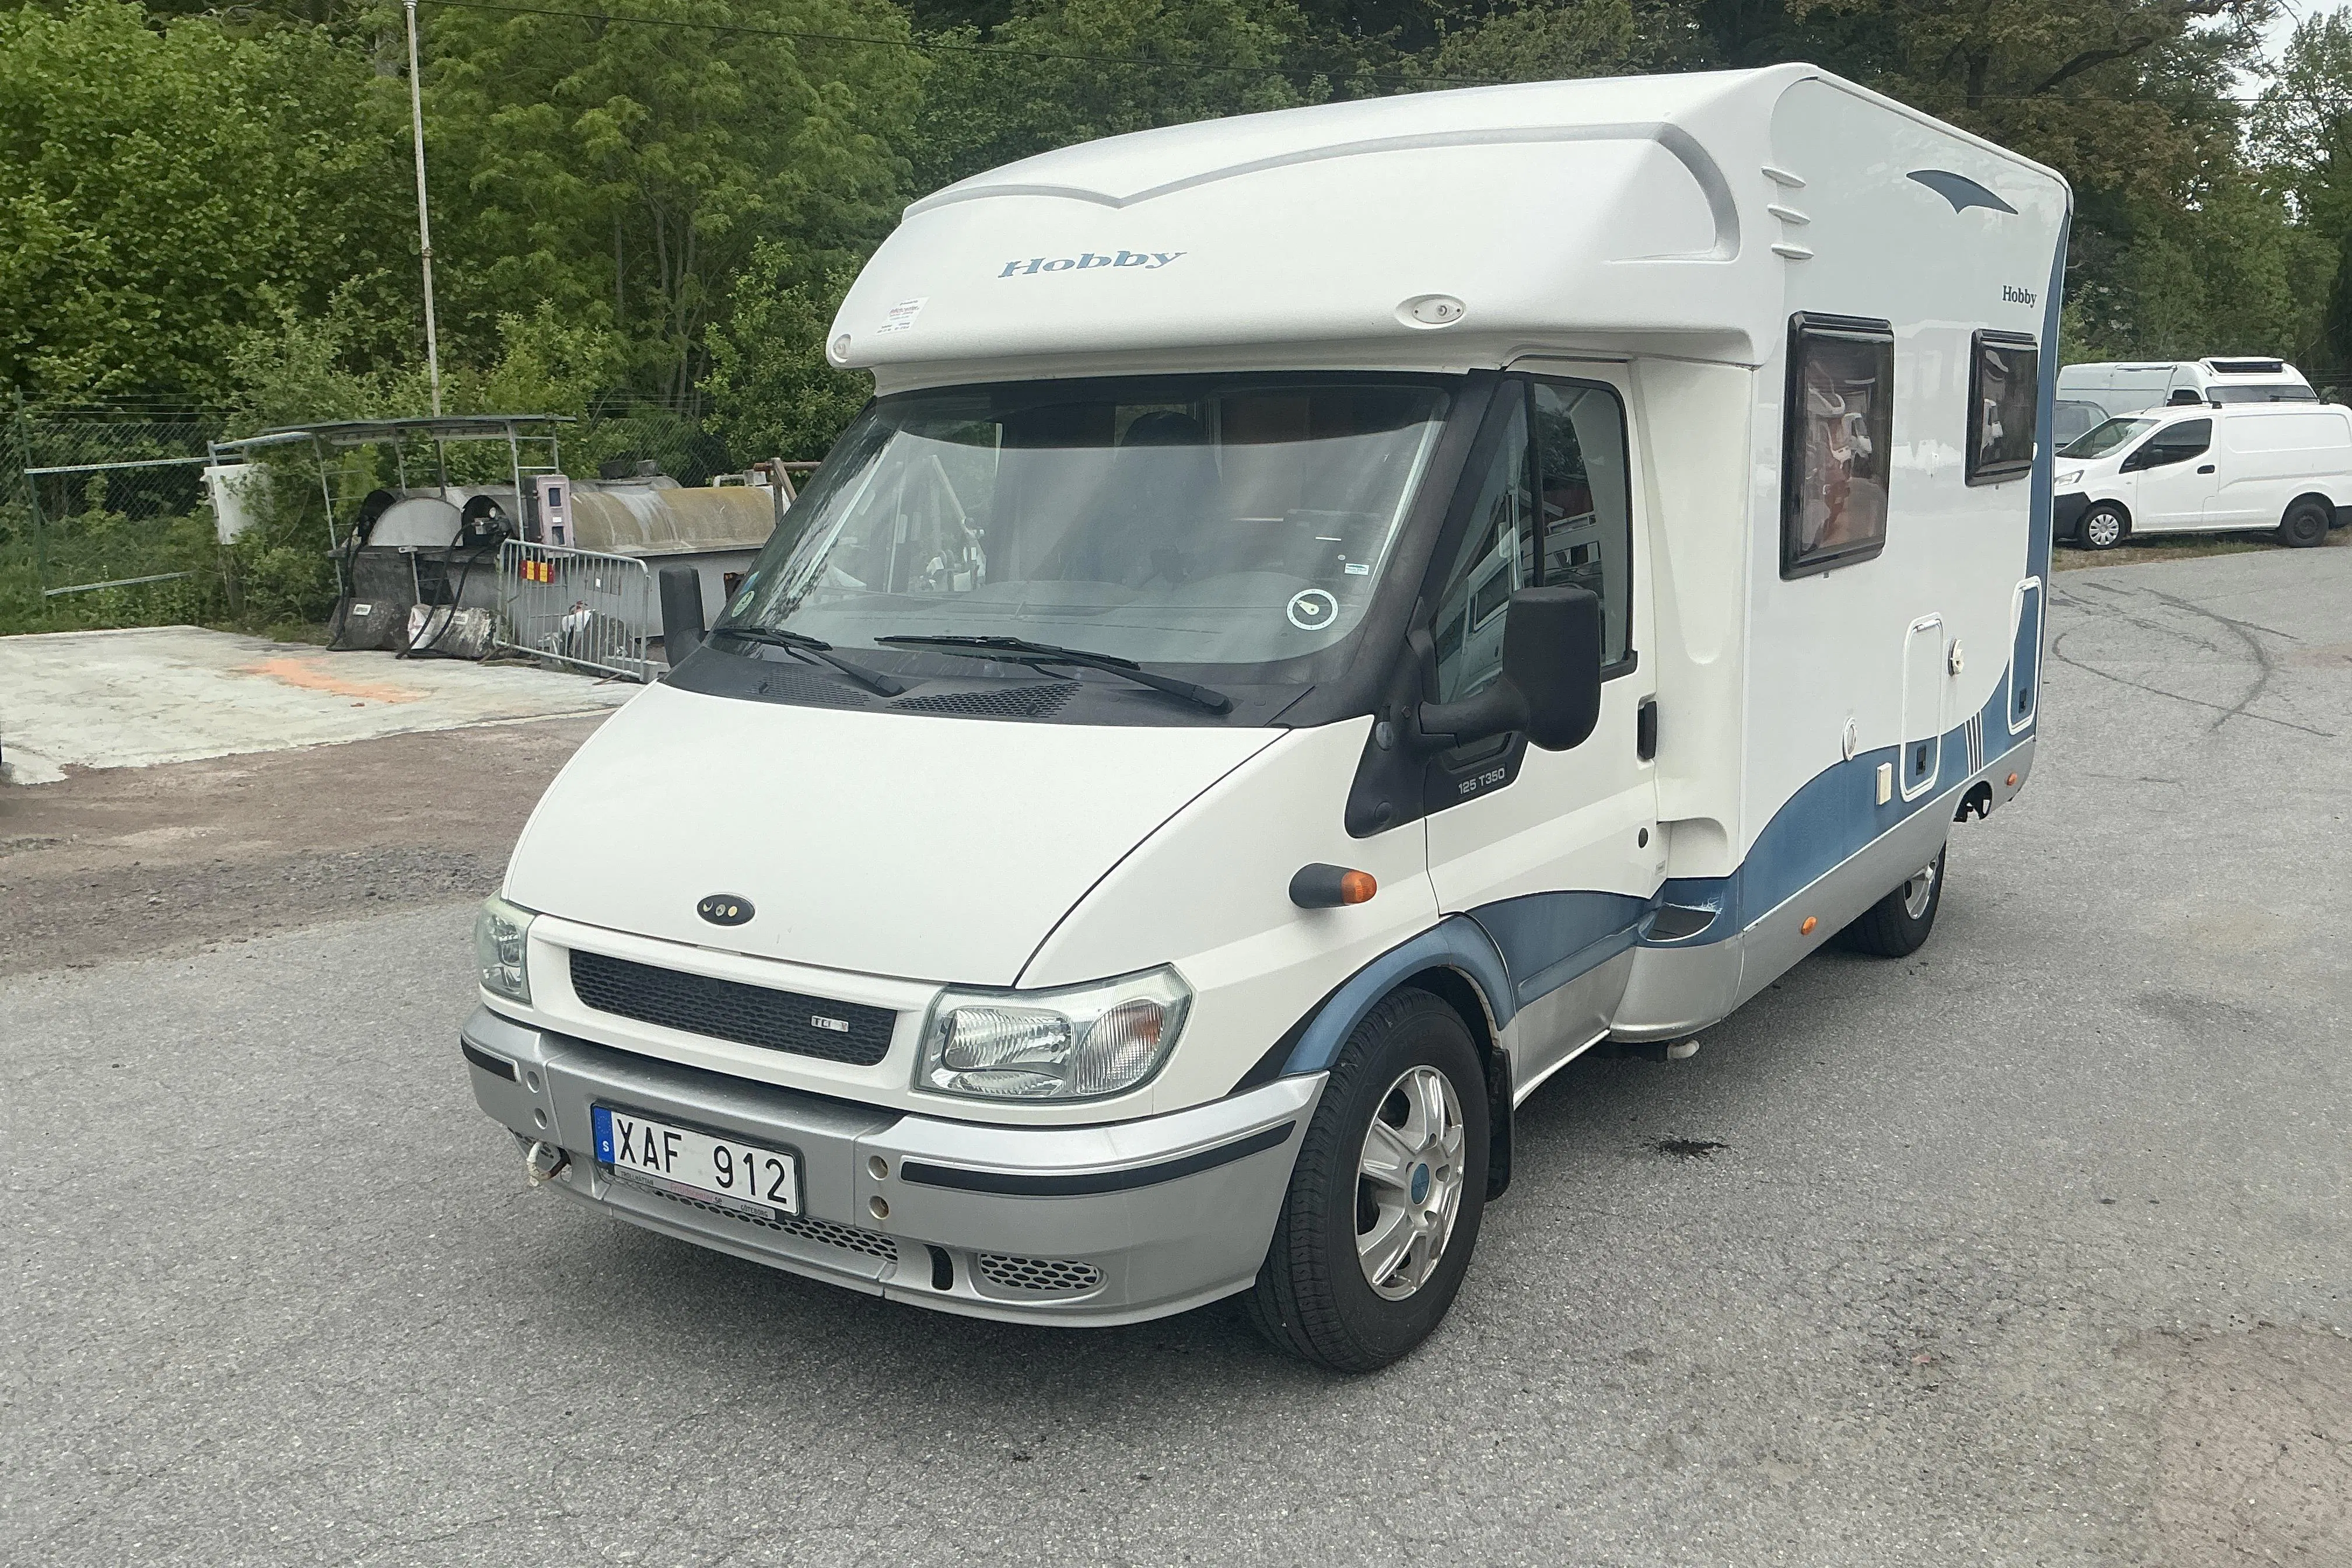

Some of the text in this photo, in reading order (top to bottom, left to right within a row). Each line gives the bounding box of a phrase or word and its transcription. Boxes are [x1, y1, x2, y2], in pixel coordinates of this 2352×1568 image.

[998, 250, 1188, 278] Hobby
[2002, 285, 2038, 308] Hobby
[1458, 767, 1505, 794] 125 T350
[602, 1140, 610, 1152] S
[617, 1118, 788, 1205] XAF 912
[740, 1203, 768, 1217] GÖTEBORG
